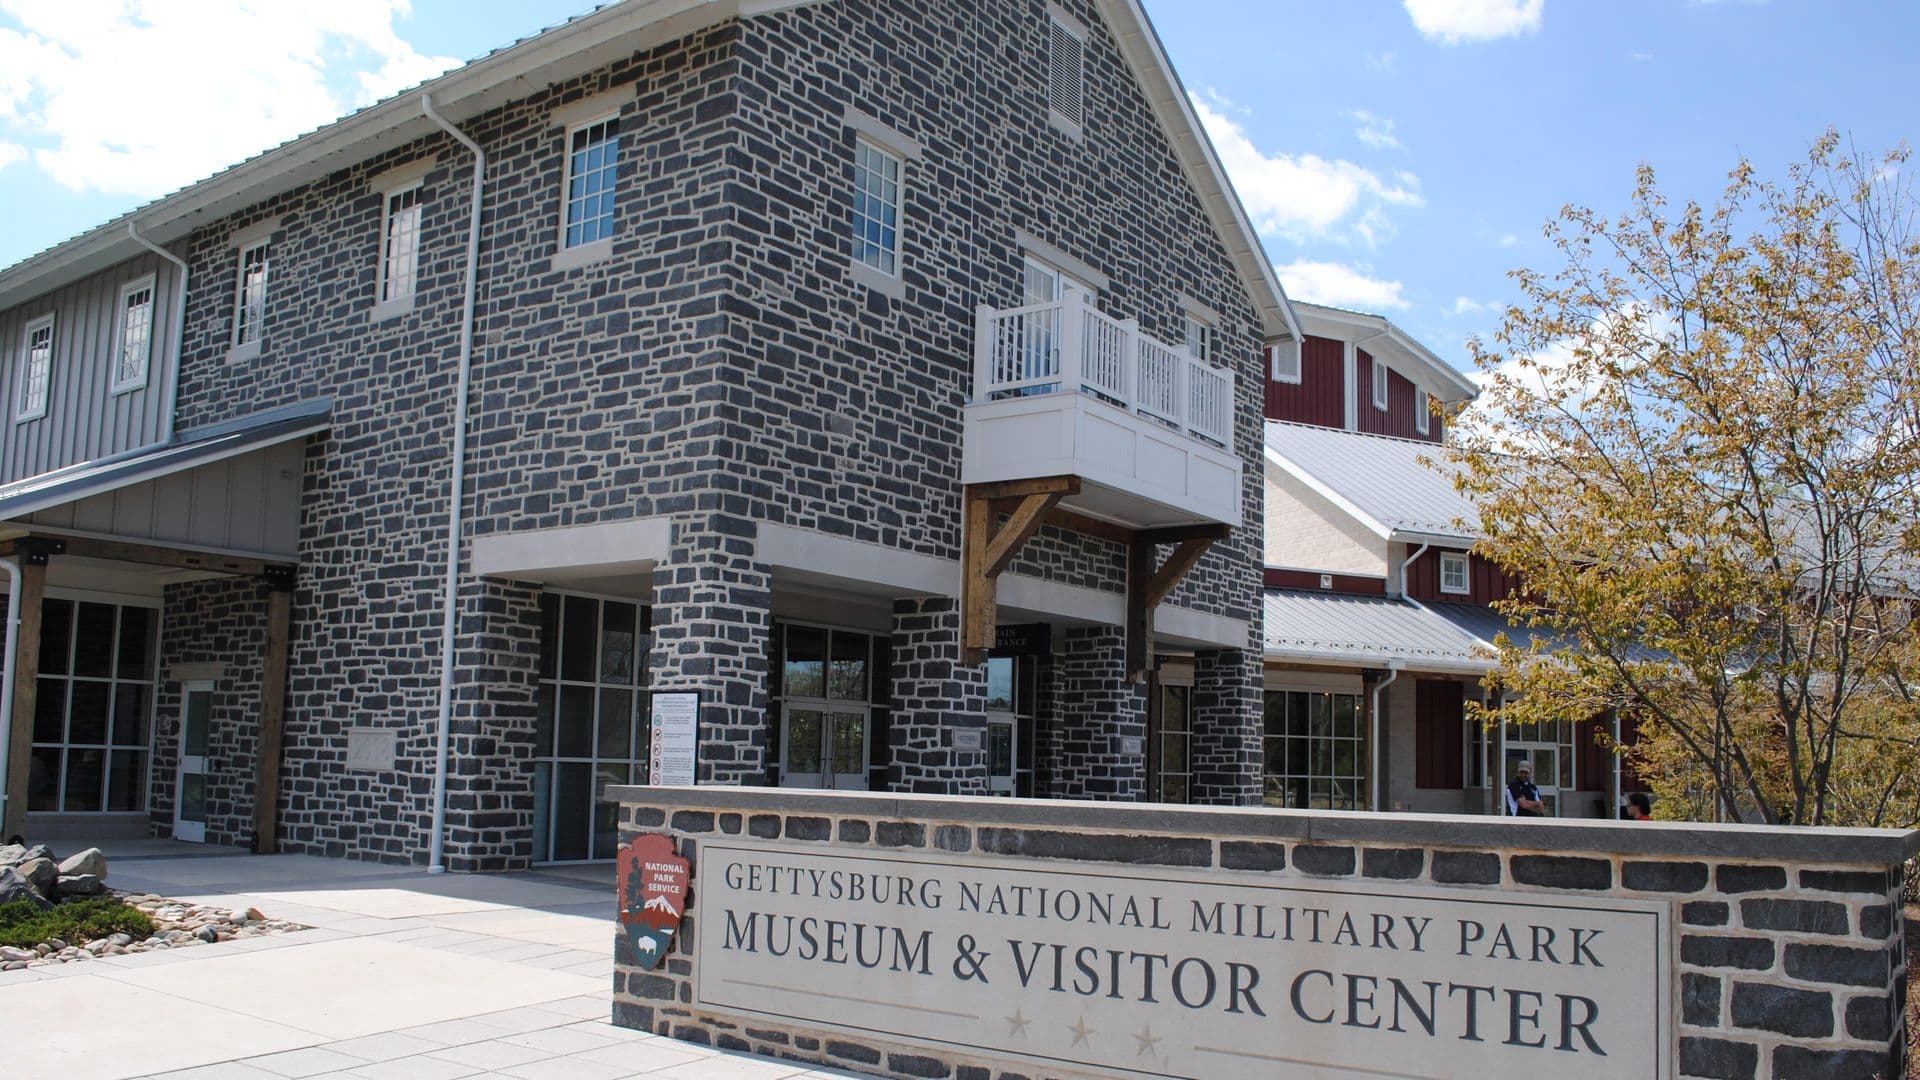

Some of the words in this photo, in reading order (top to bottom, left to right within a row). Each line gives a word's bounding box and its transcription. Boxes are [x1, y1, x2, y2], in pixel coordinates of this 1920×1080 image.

[645, 862, 685, 874] NATIONAL
[653, 873, 675, 883] PARK
[648, 883, 681, 894] SERVICE
[724, 862, 943, 909] GETTYSBURG
[958, 881, 1172, 930] NATIONAL
[1190, 899, 1433, 953] MILITARY
[1456, 919, 1606, 968] PARK
[722, 909, 934, 976] MUSEUM
[952, 934, 991, 984] &
[1006, 939, 1267, 1017] VISITOR
[1289, 968, 1608, 1057] CENTER
